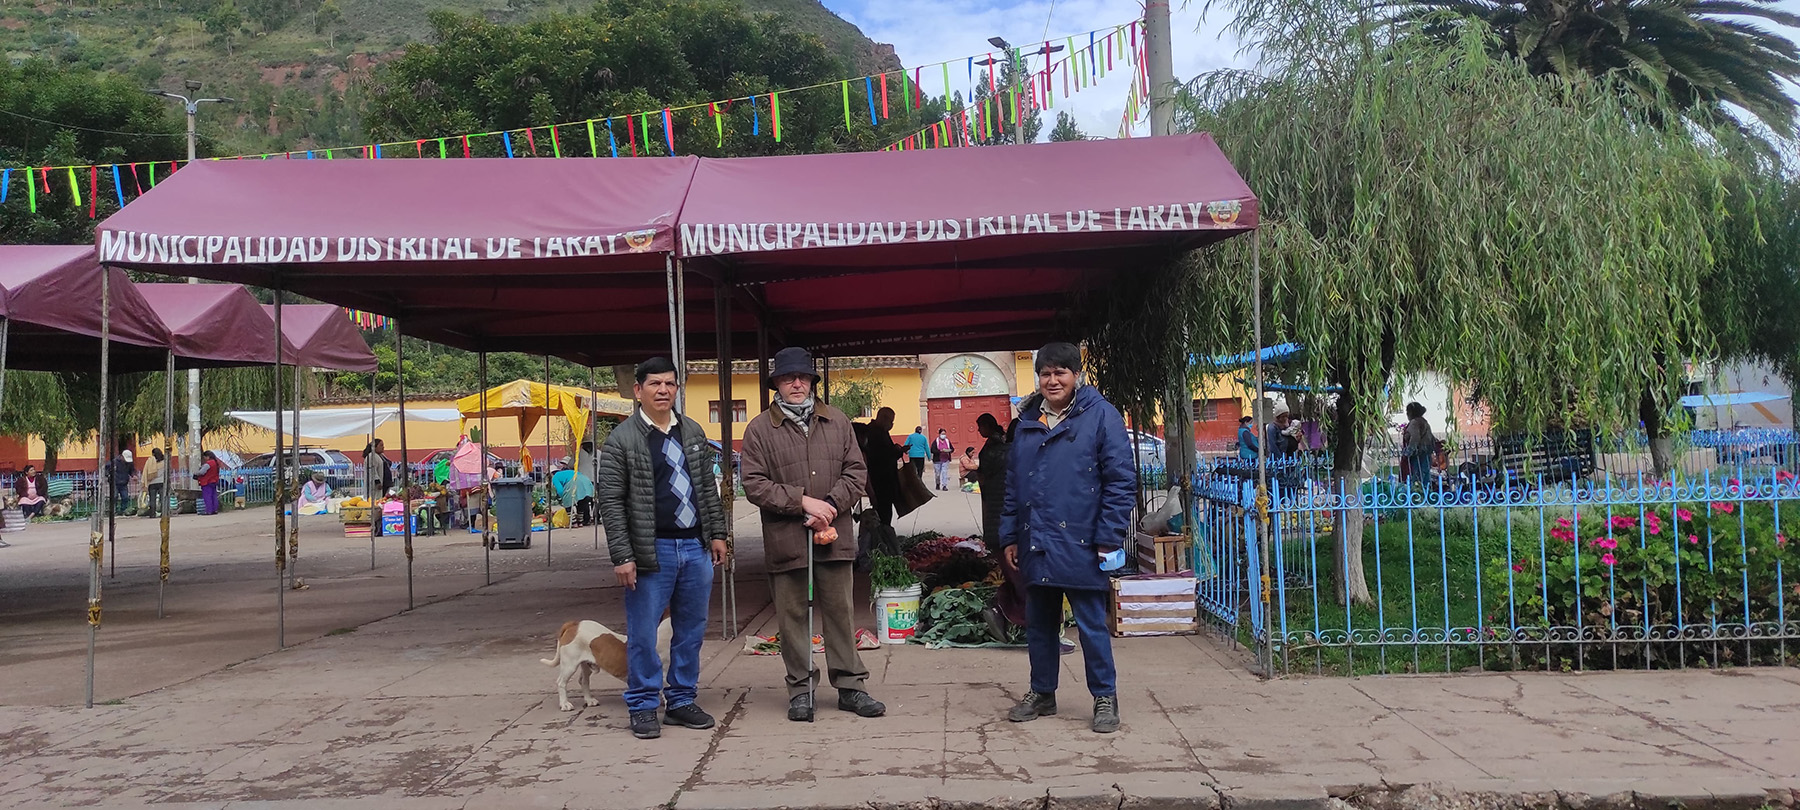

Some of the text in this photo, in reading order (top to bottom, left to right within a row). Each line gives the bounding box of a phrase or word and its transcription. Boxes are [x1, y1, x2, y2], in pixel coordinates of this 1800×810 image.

[100, 230, 328, 263] MUNICIPALIDAD
[486, 237, 521, 259] DE
[680, 221, 907, 256] MUNICIPALIDAD
[1066, 209, 1102, 231] DE
